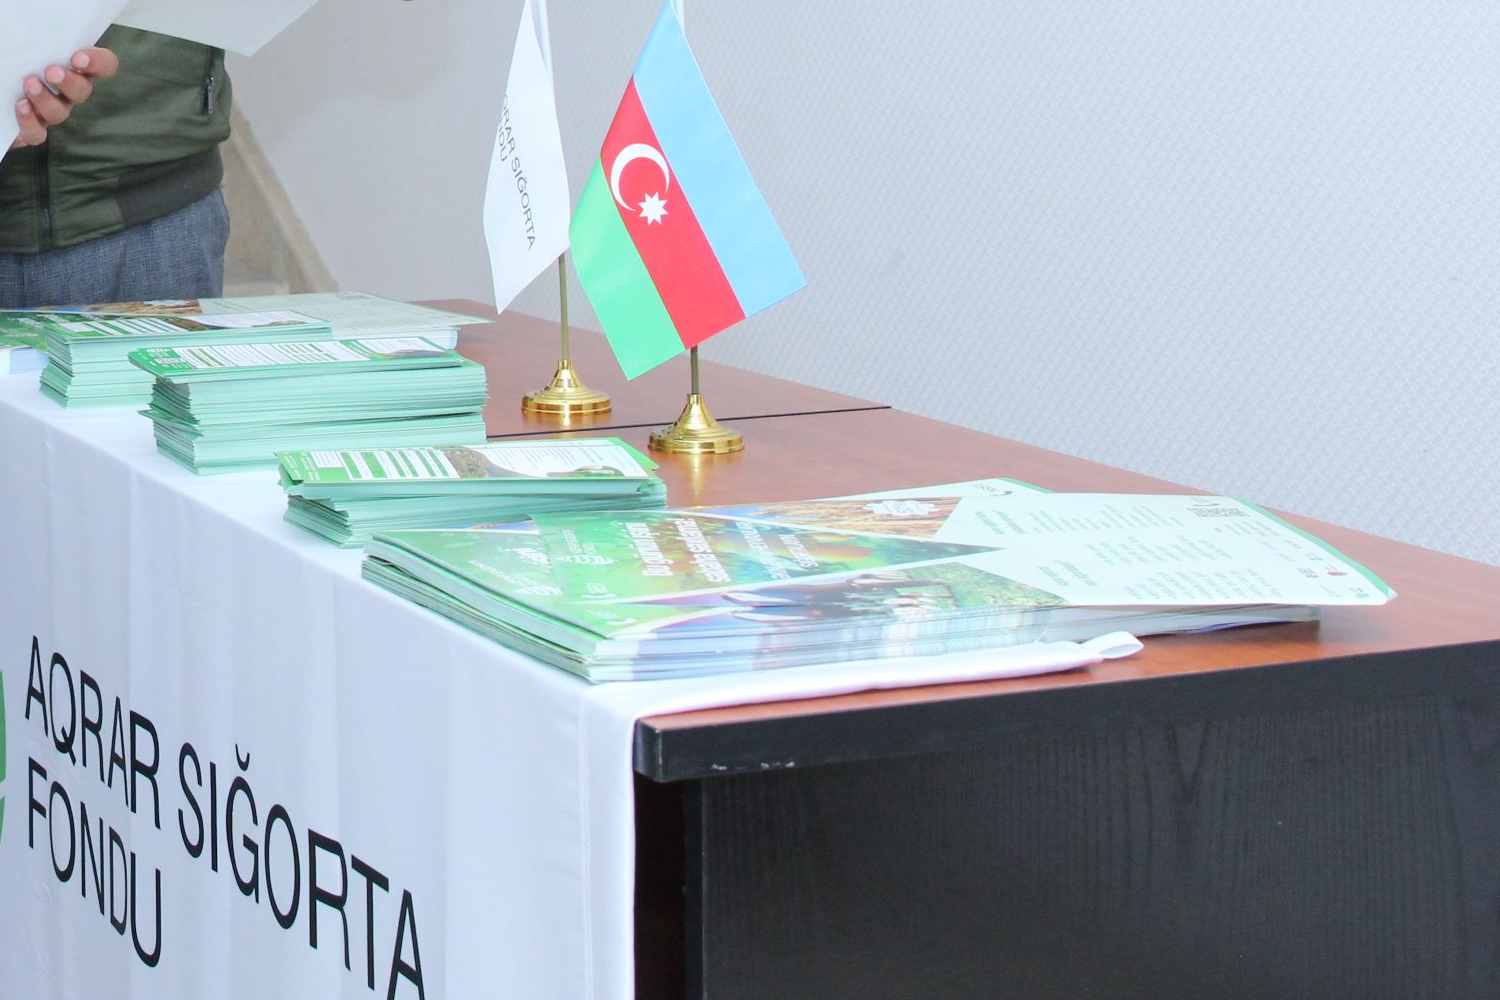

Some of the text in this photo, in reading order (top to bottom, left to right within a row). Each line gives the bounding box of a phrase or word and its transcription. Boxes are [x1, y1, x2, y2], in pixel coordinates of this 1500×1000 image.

[510, 156, 536, 250] SIĞORTA
[25, 635, 426, 1000] AQRAR SIĞORTA
[28, 757, 162, 968] FONDU
